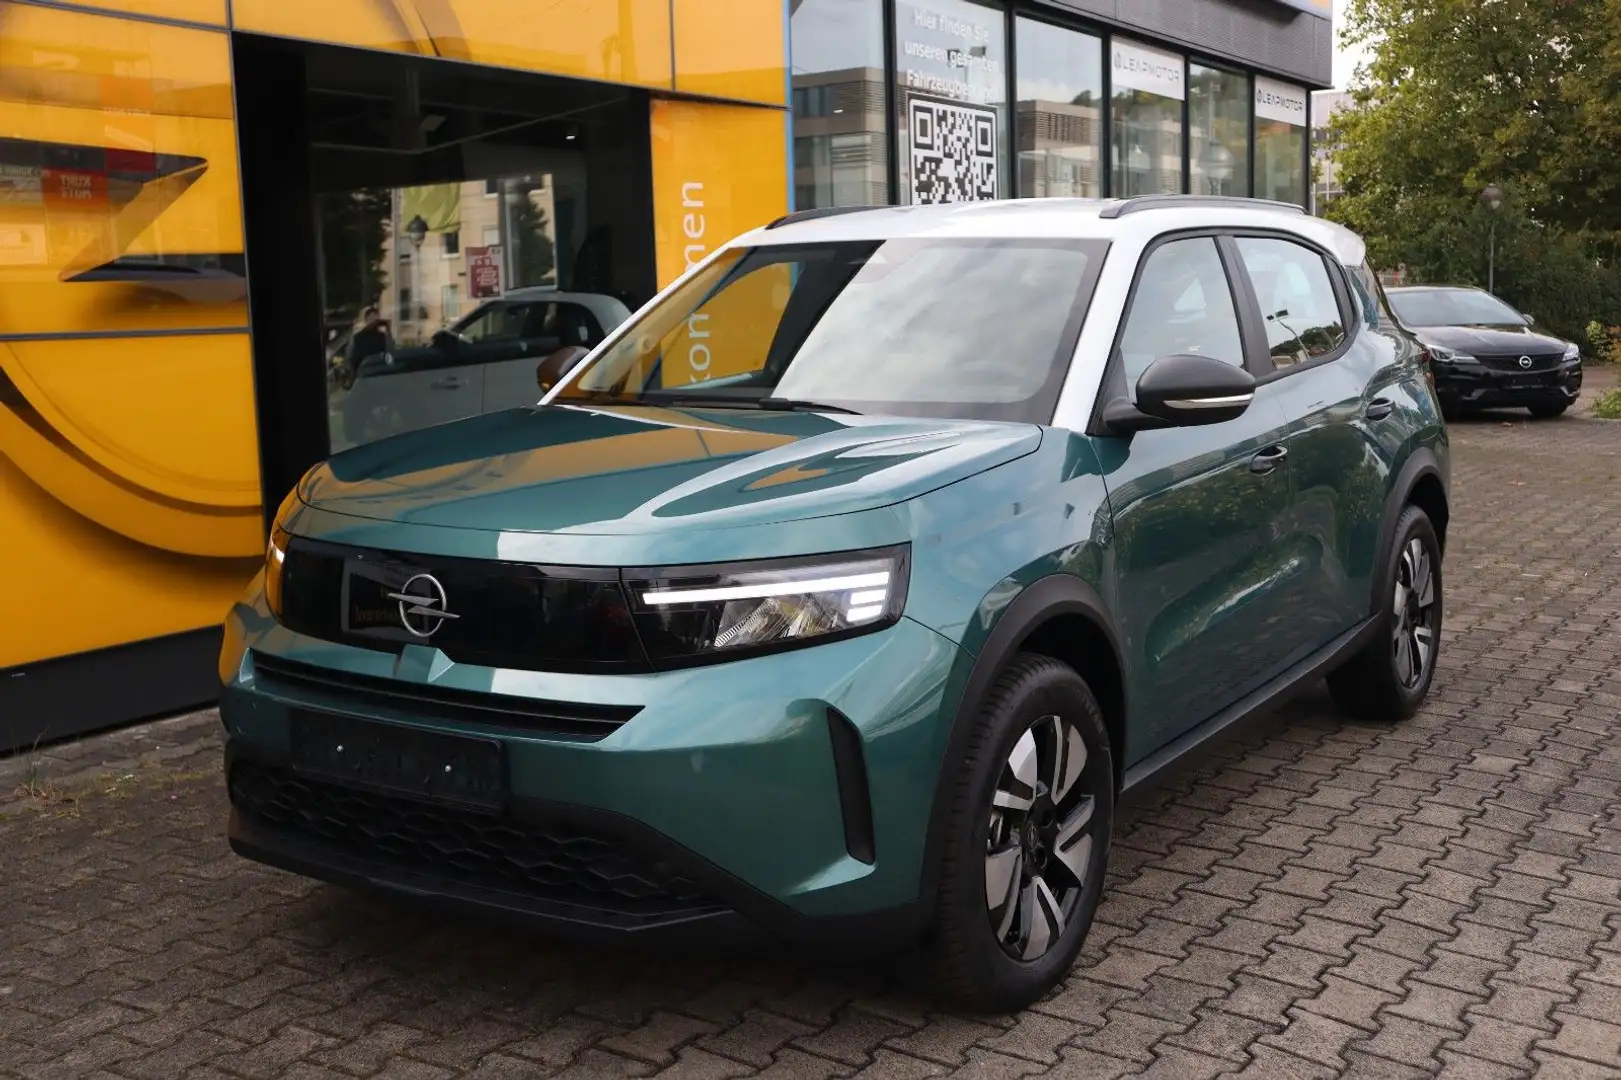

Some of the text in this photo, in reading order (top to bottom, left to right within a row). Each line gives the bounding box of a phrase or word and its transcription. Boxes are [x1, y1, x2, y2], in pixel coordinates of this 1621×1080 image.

[914, 9, 990, 44] Hier finden Sie
[904, 40, 999, 72] unseren gesamten
